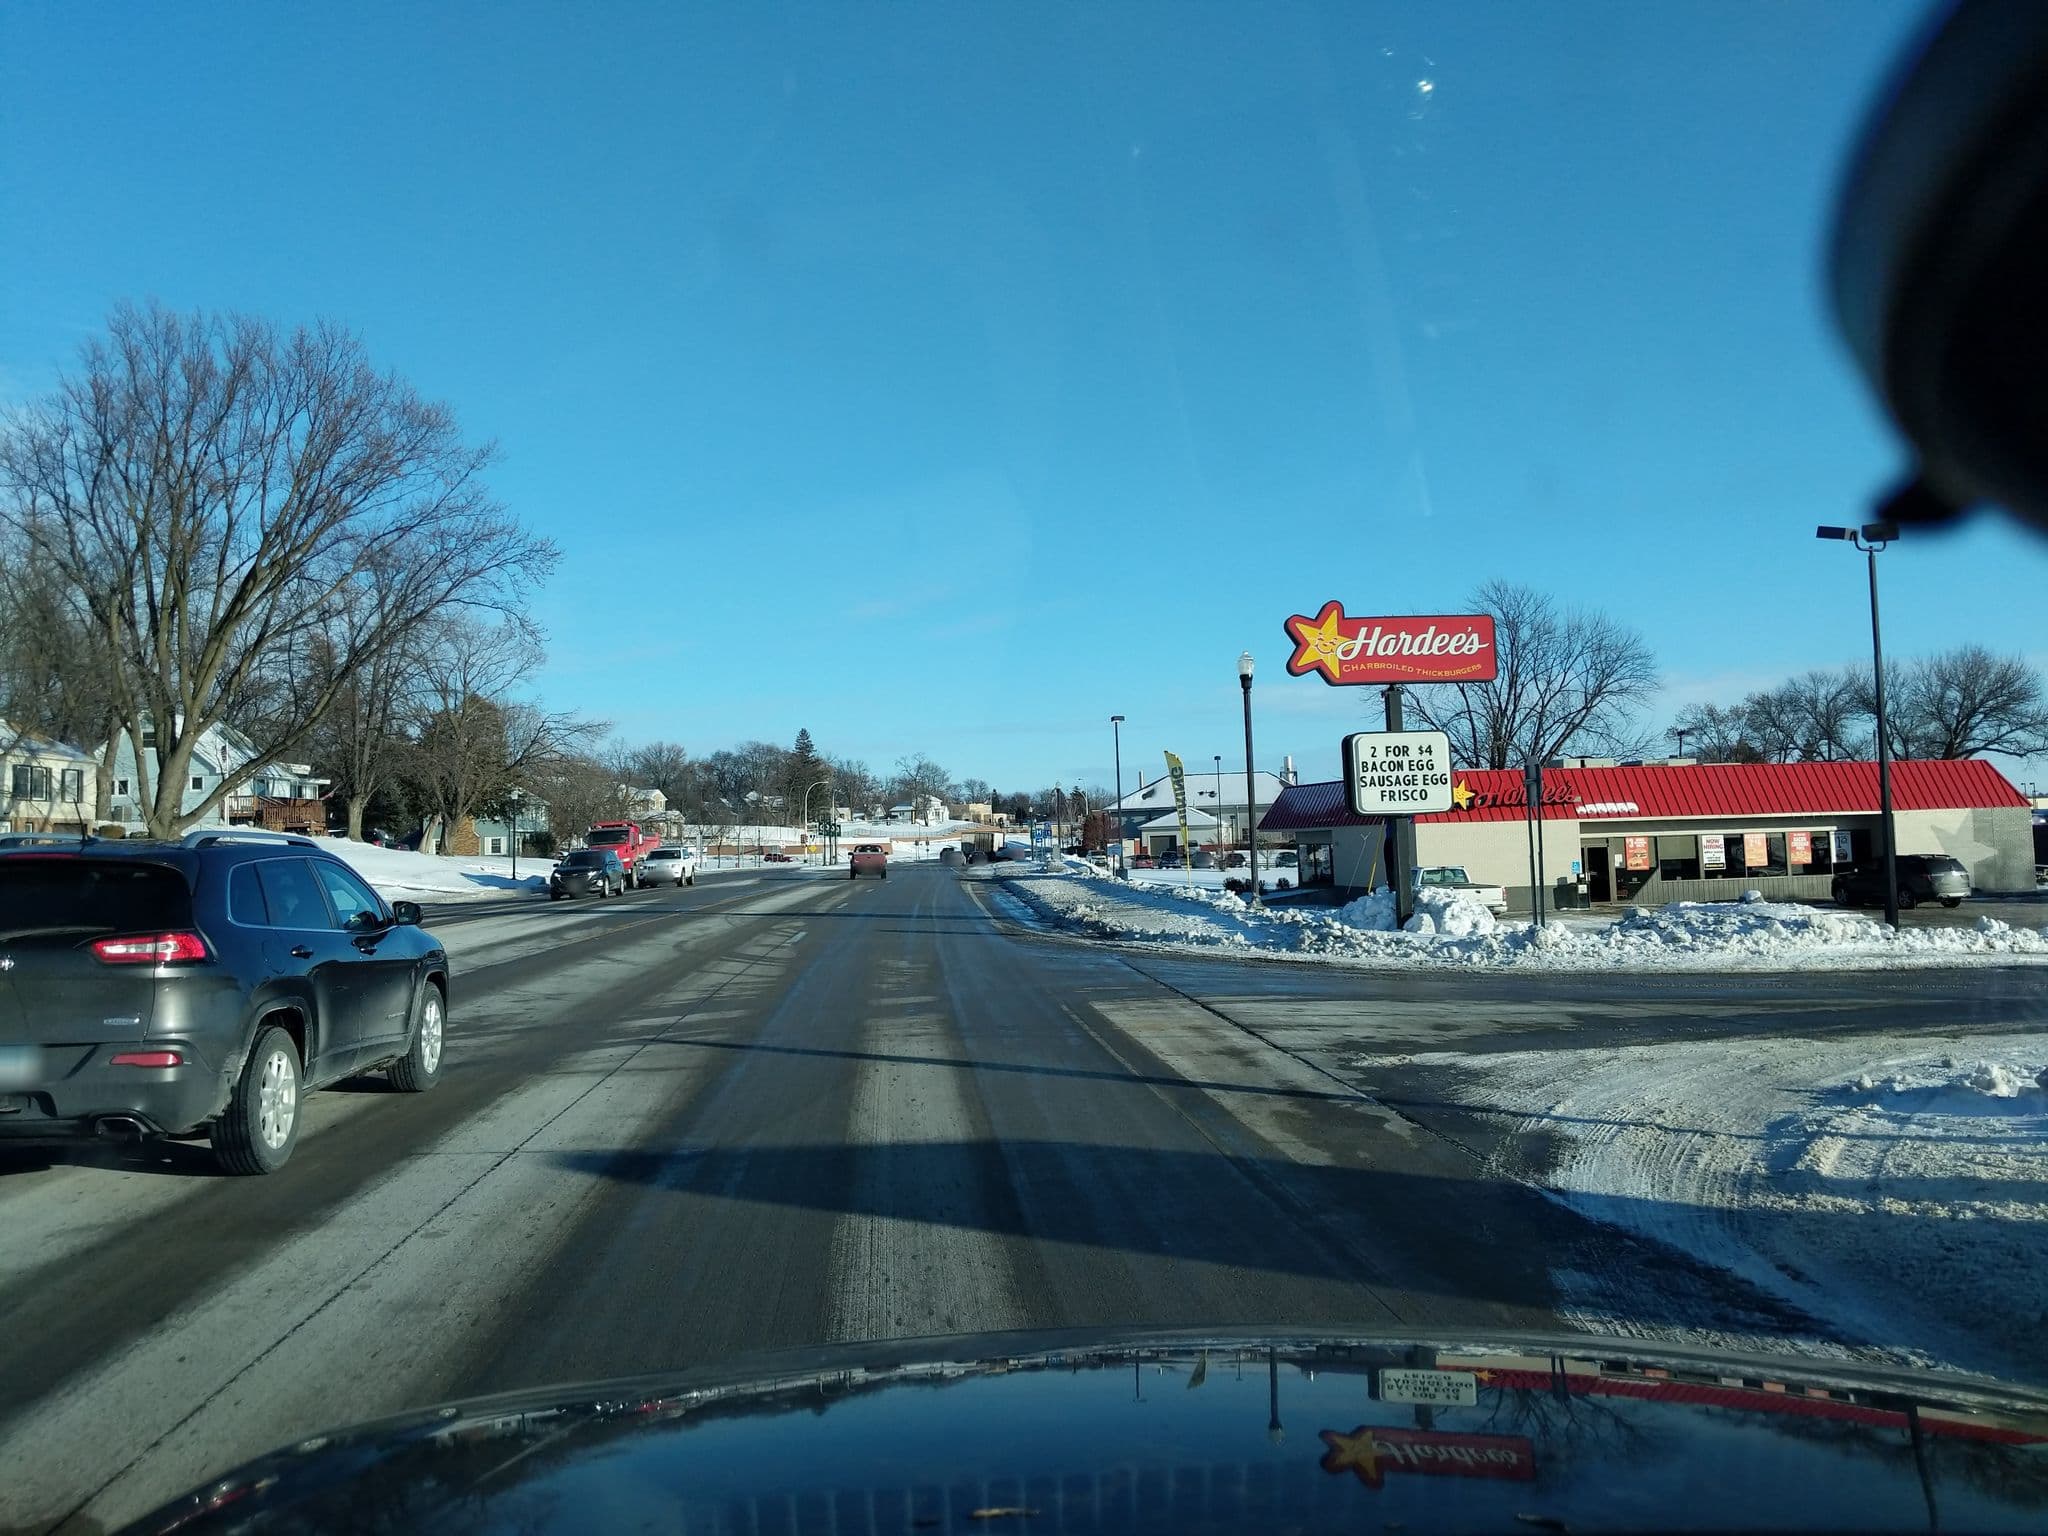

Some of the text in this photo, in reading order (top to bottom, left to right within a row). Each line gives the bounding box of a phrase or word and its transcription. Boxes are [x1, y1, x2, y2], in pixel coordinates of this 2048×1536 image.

[1336, 625, 1490, 661] Hardee's
[1342, 662, 1482, 677] CHARBROILED THICKBURGERS
[1370, 744, 1433, 758] 2 FOR $4
[1361, 759, 1435, 773] BACON EGG
[1360, 773, 1448, 788] SAUSAGE EGG
[1380, 789, 1428, 802] FRISCO
[1474, 781, 1577, 808] Haree's
